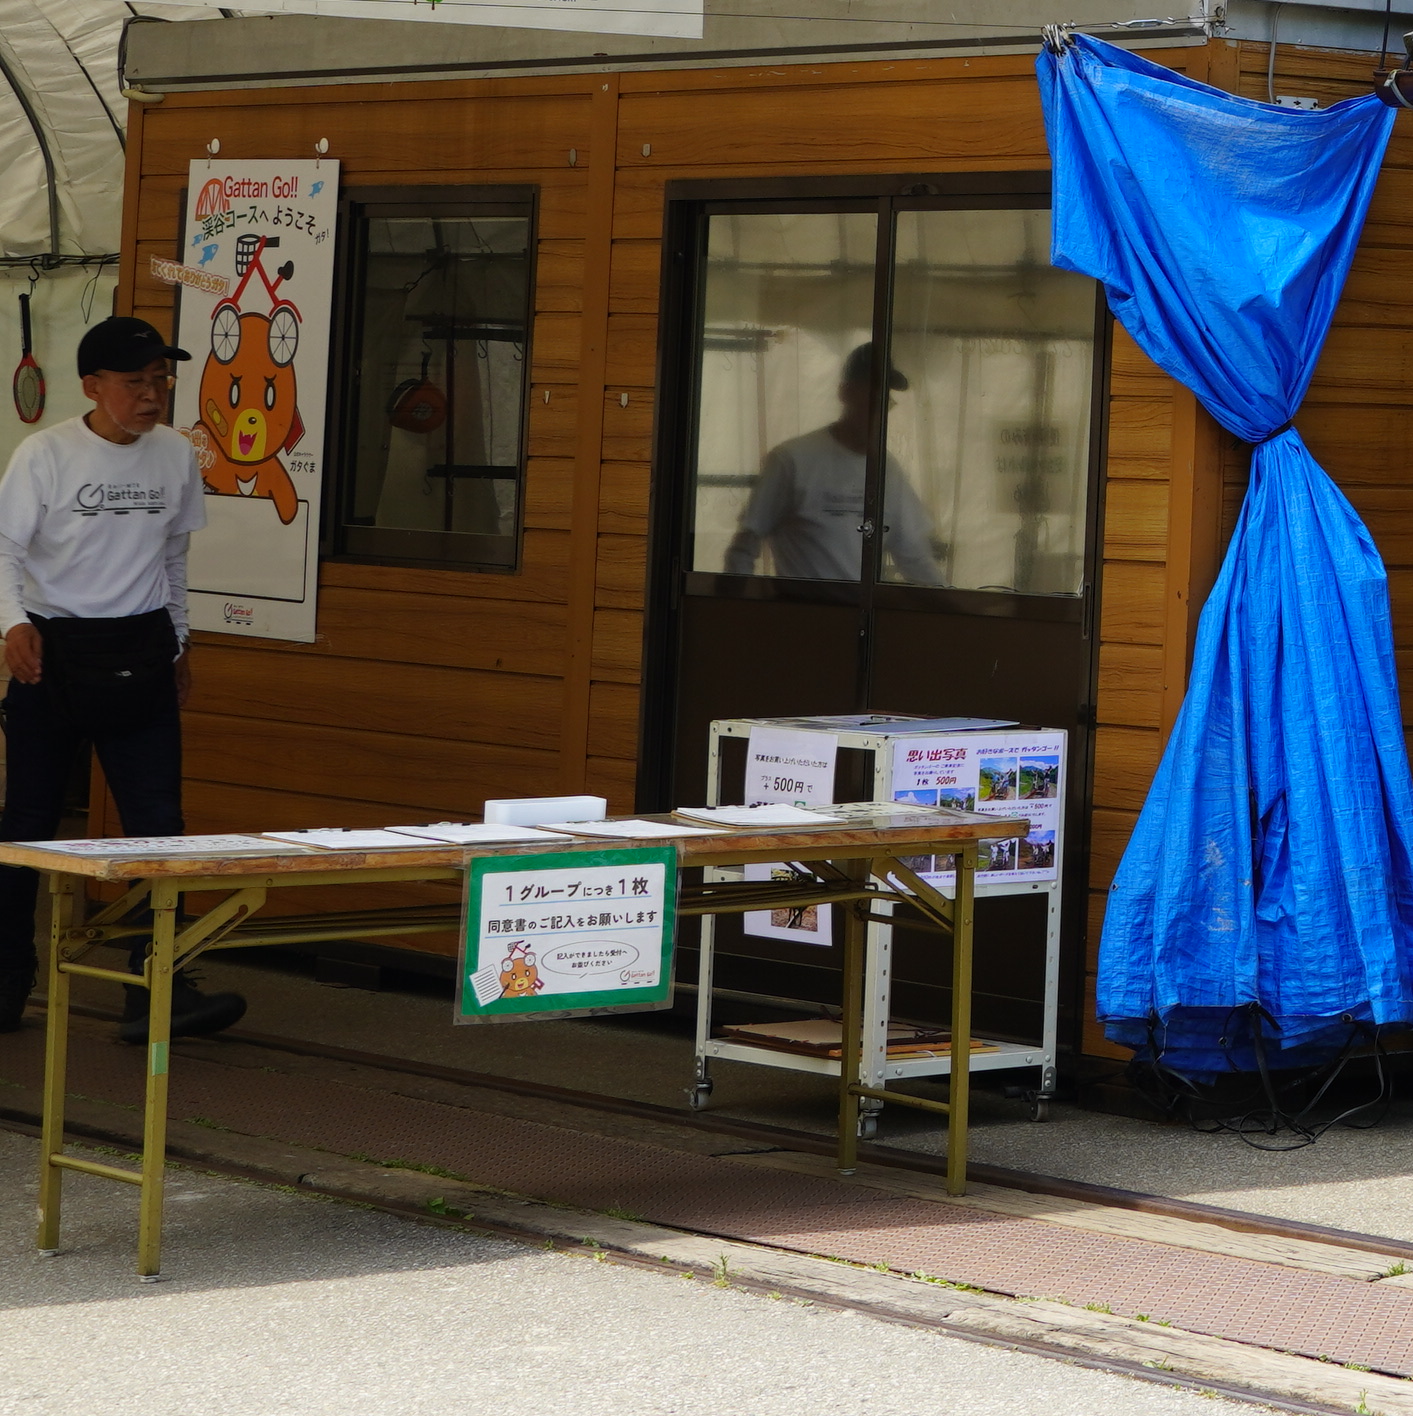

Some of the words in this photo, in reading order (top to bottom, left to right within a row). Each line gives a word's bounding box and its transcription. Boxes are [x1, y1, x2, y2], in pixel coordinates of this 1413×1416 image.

[224, 176, 269, 199] Gattan
[272, 176, 299, 199] Go!!
[202, 205, 269, 240] 渓谷コースへ
[272, 206, 316, 236] ようこそ
[107, 488, 147, 502] Gattan
[906, 747, 968, 763] 思い出写真
[773, 776, 804, 794] 500円
[936, 776, 957, 785] 500円
[488, 910, 658, 934] 同意書のご記入をお願いします
